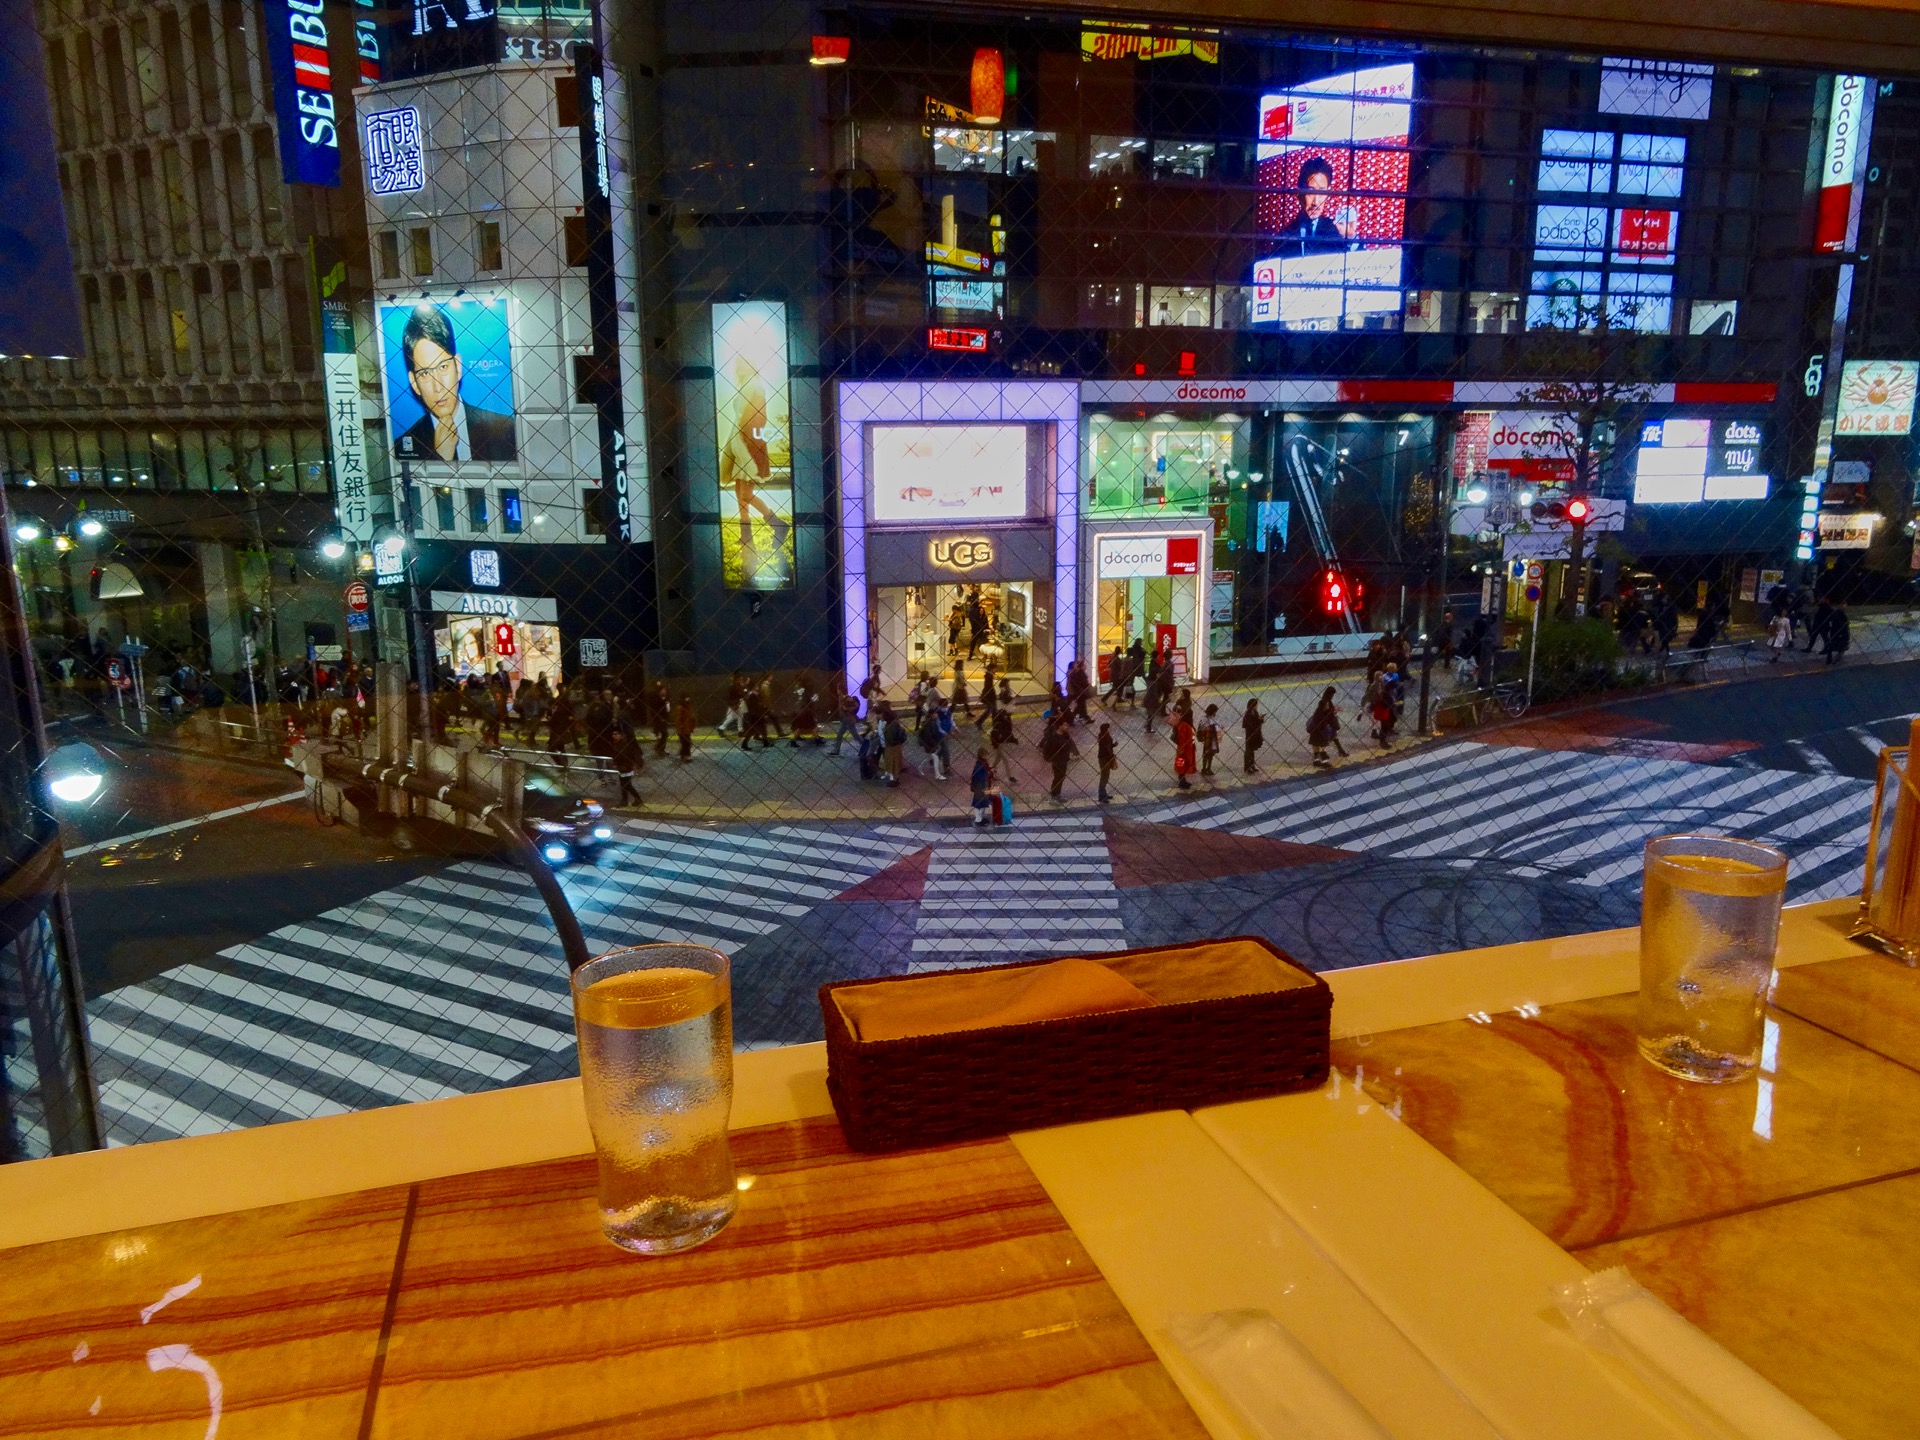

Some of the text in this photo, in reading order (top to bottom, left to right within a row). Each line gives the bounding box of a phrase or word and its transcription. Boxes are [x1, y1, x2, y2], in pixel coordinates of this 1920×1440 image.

[1831, 75, 1859, 175] docomo
[322, 300, 351, 312] SMBC
[1804, 354, 1824, 397] UGG
[1177, 382, 1246, 399] docomo
[333, 371, 366, 524] 三井住友銀行
[1493, 426, 1576, 446] docomo
[1725, 449, 1755, 472] my
[613, 429, 630, 540] ALOOK
[935, 541, 991, 567] UGG
[1104, 552, 1163, 565] docomo
[378, 574, 405, 586] ALOOK
[461, 594, 519, 617] ALOOK
